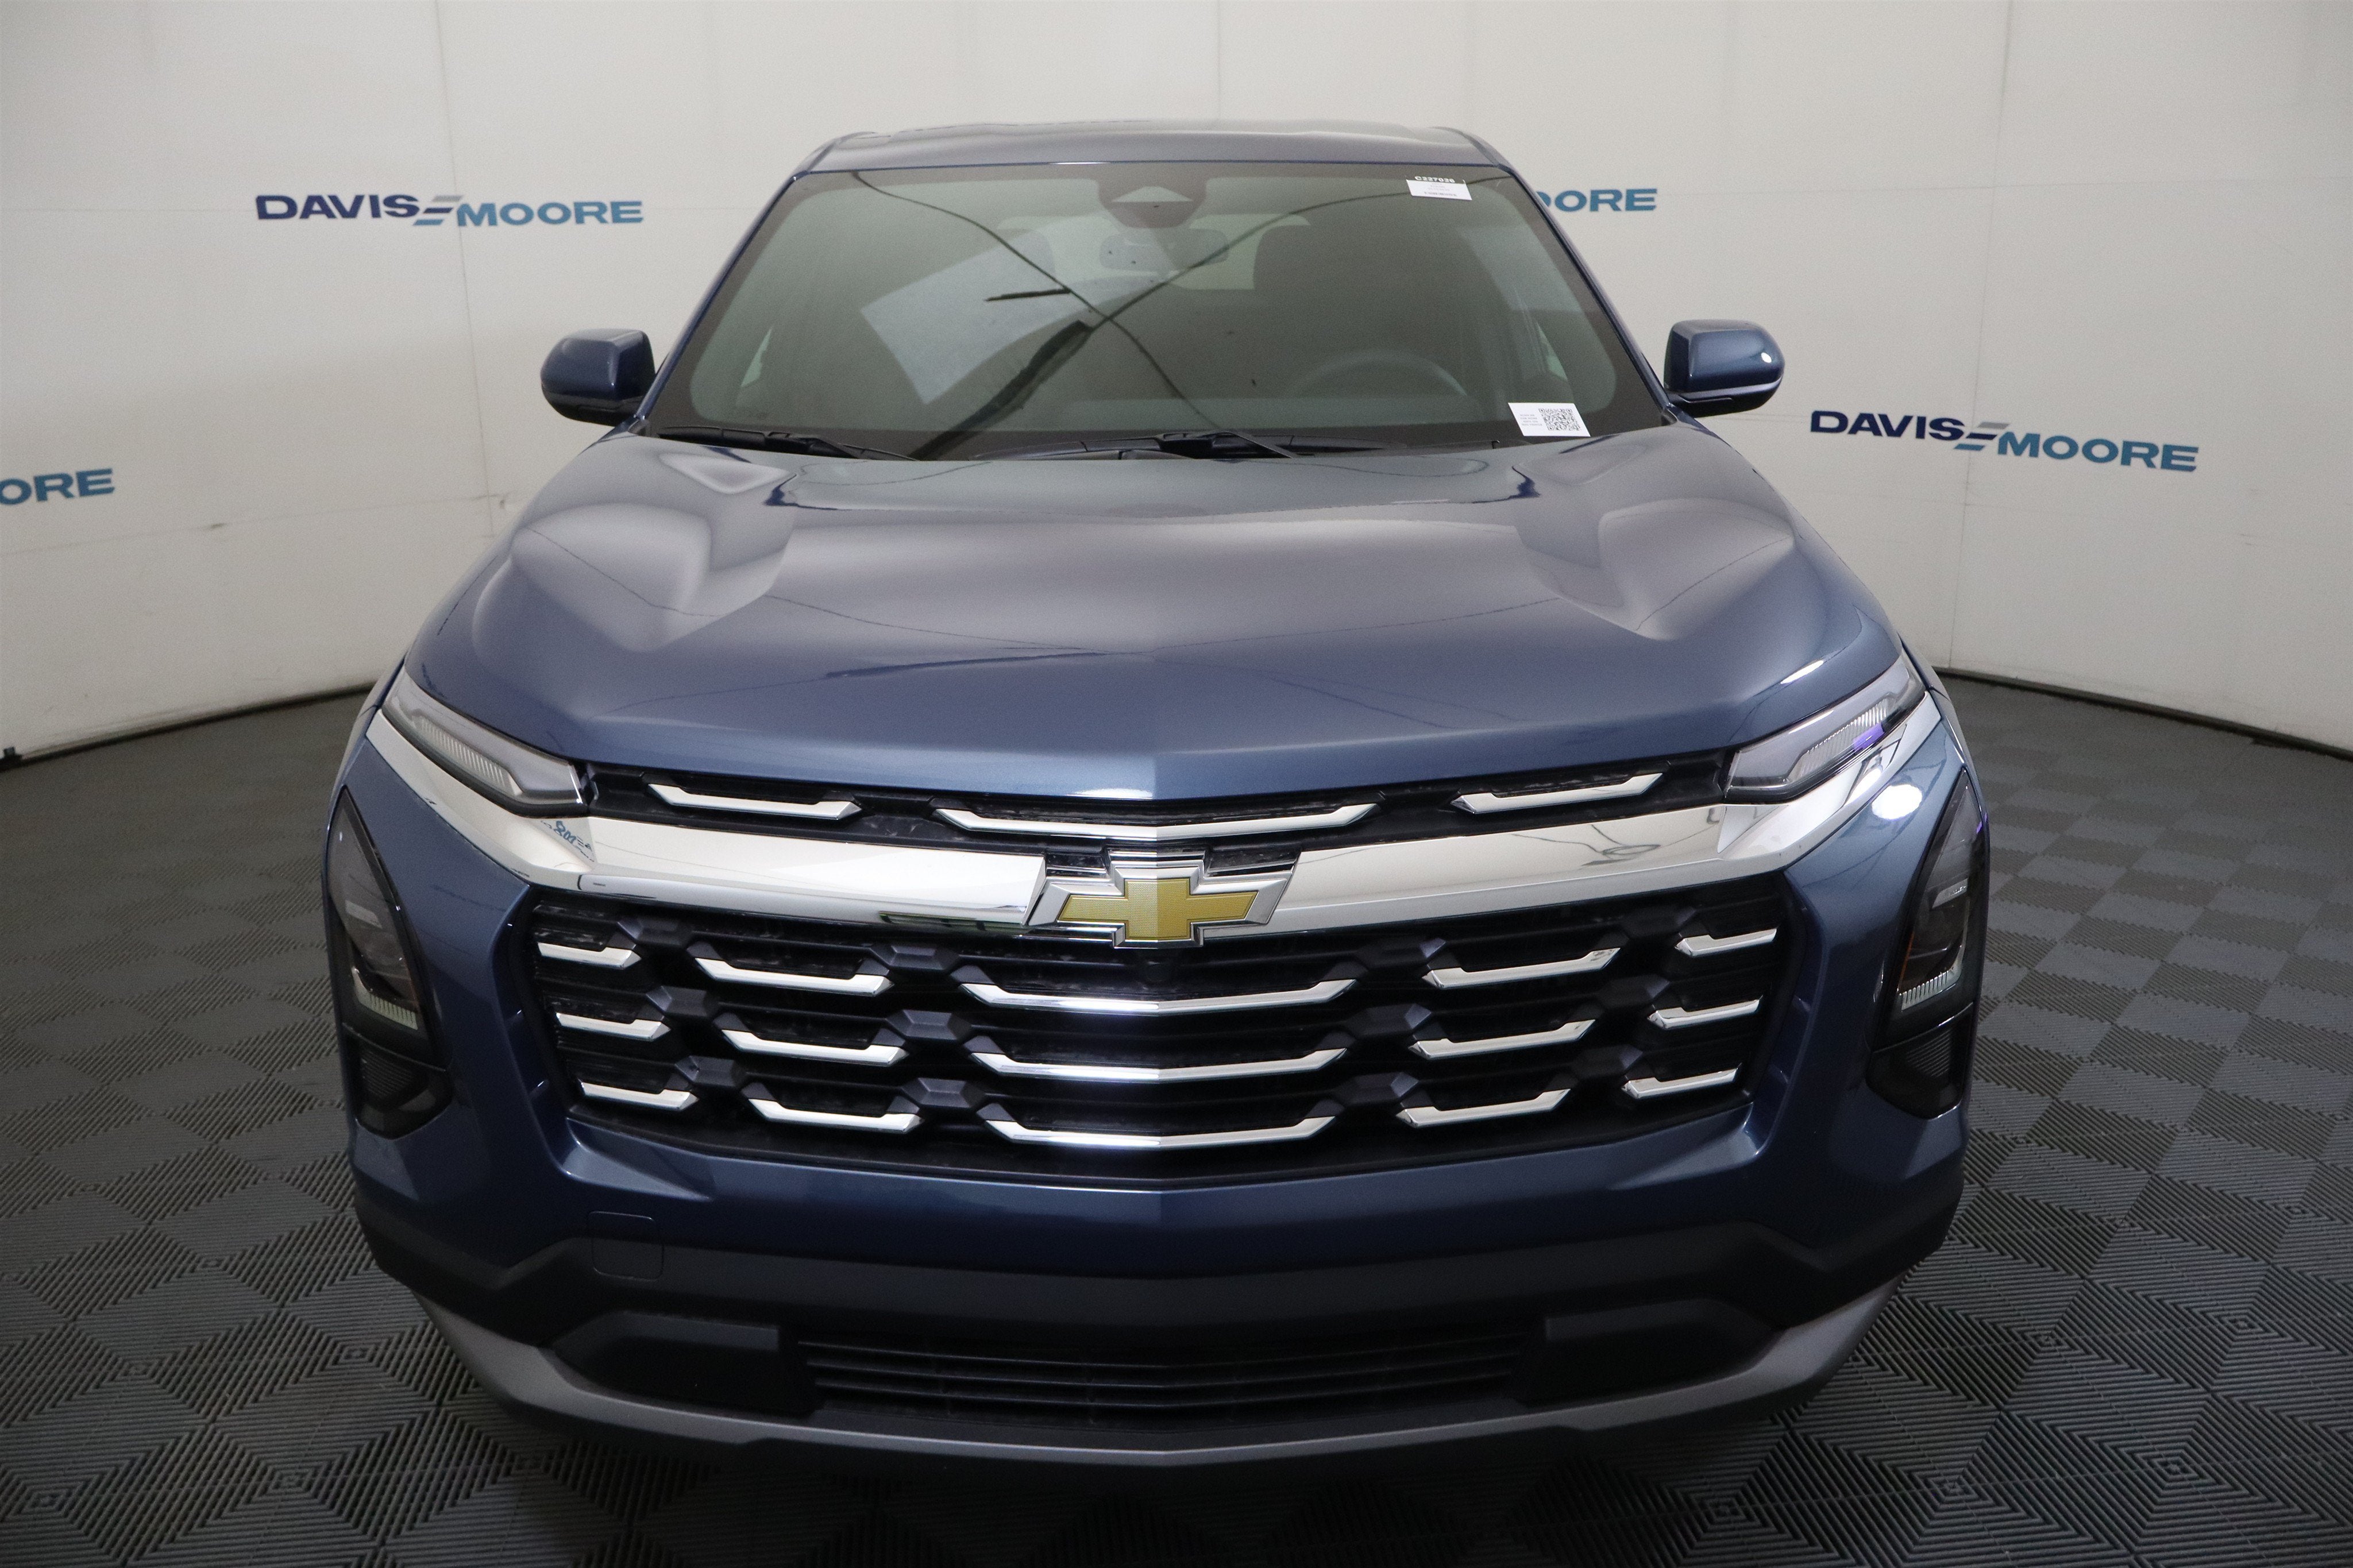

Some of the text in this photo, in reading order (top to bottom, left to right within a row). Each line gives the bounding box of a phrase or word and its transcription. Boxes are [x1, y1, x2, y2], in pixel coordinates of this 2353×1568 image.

[255, 194, 643, 226] DAVIS MOORE
[1810, 410, 2198, 472] DAVIS MOORE
[0, 468, 115, 505] ORE
